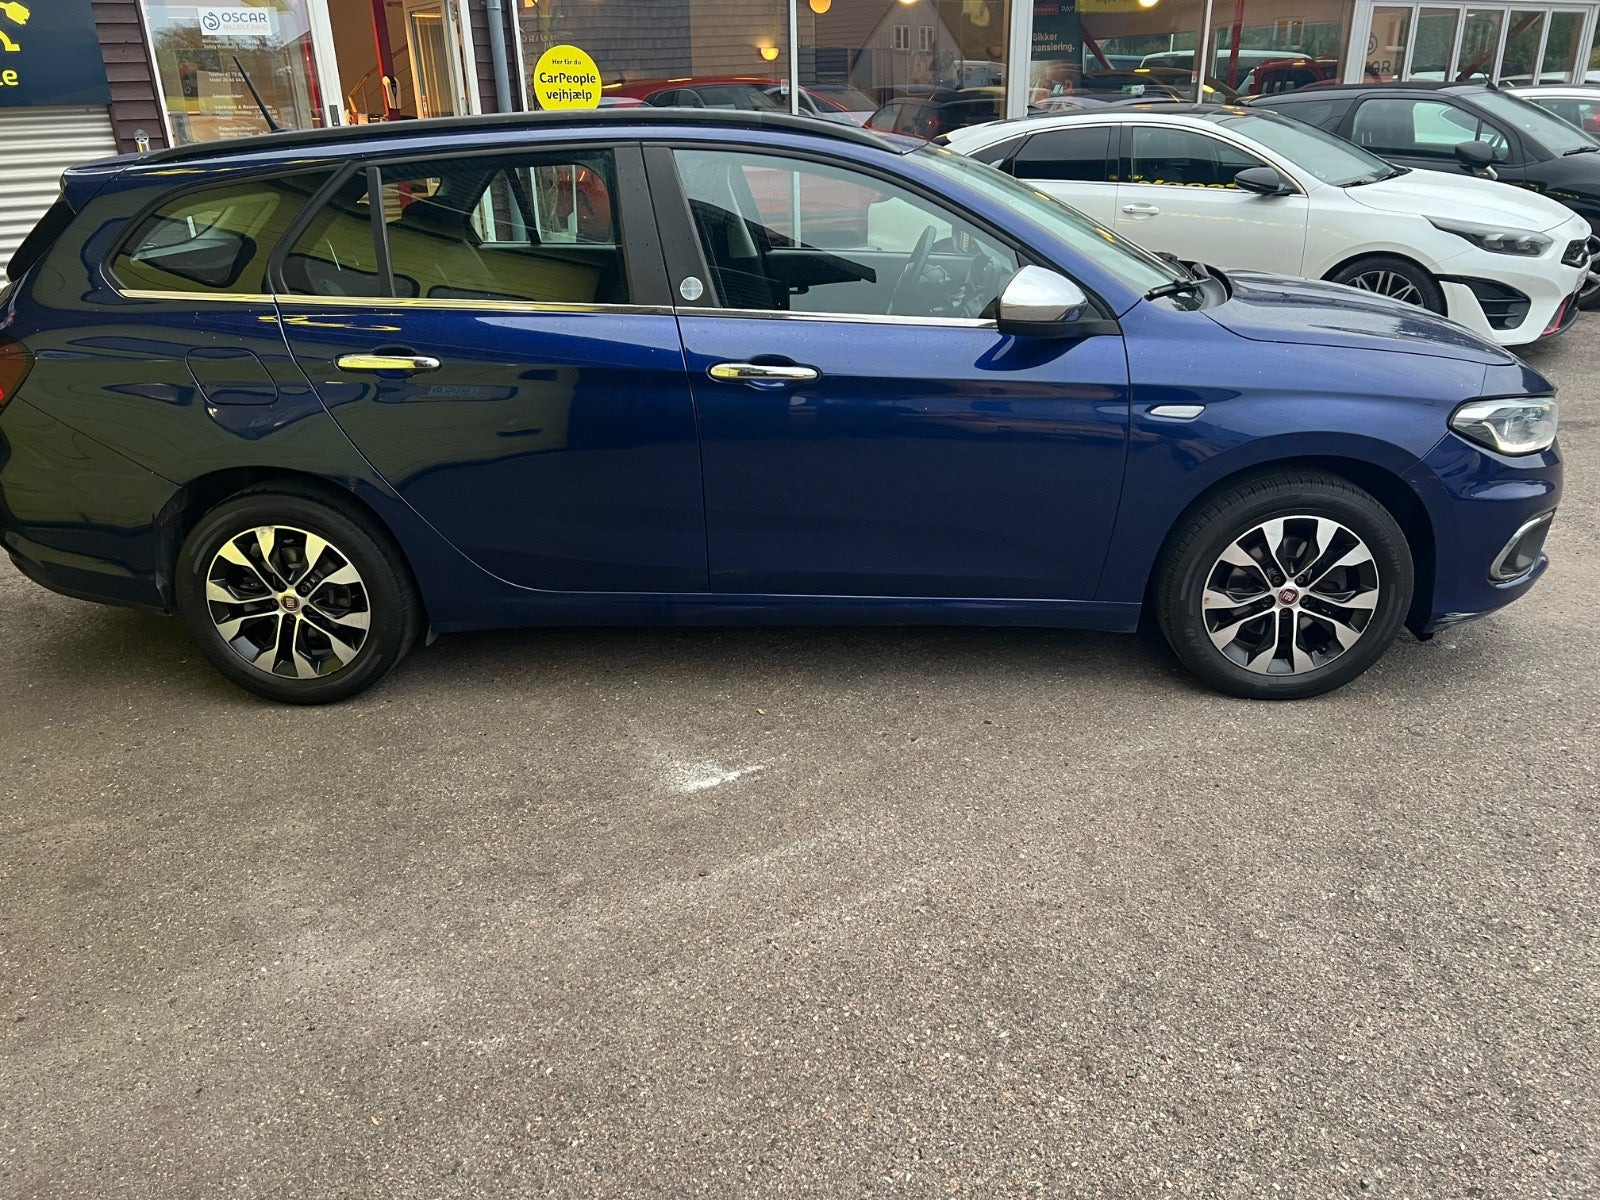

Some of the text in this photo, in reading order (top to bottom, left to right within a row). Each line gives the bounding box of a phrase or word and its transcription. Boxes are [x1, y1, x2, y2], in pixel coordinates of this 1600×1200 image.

[221, 12, 267, 23] OSCAR
[1032, 32, 1058, 41] Sikker
[0, 69, 19, 86] e
[539, 72, 597, 86] CarPeople
[546, 88, 593, 103] vejhjælp
